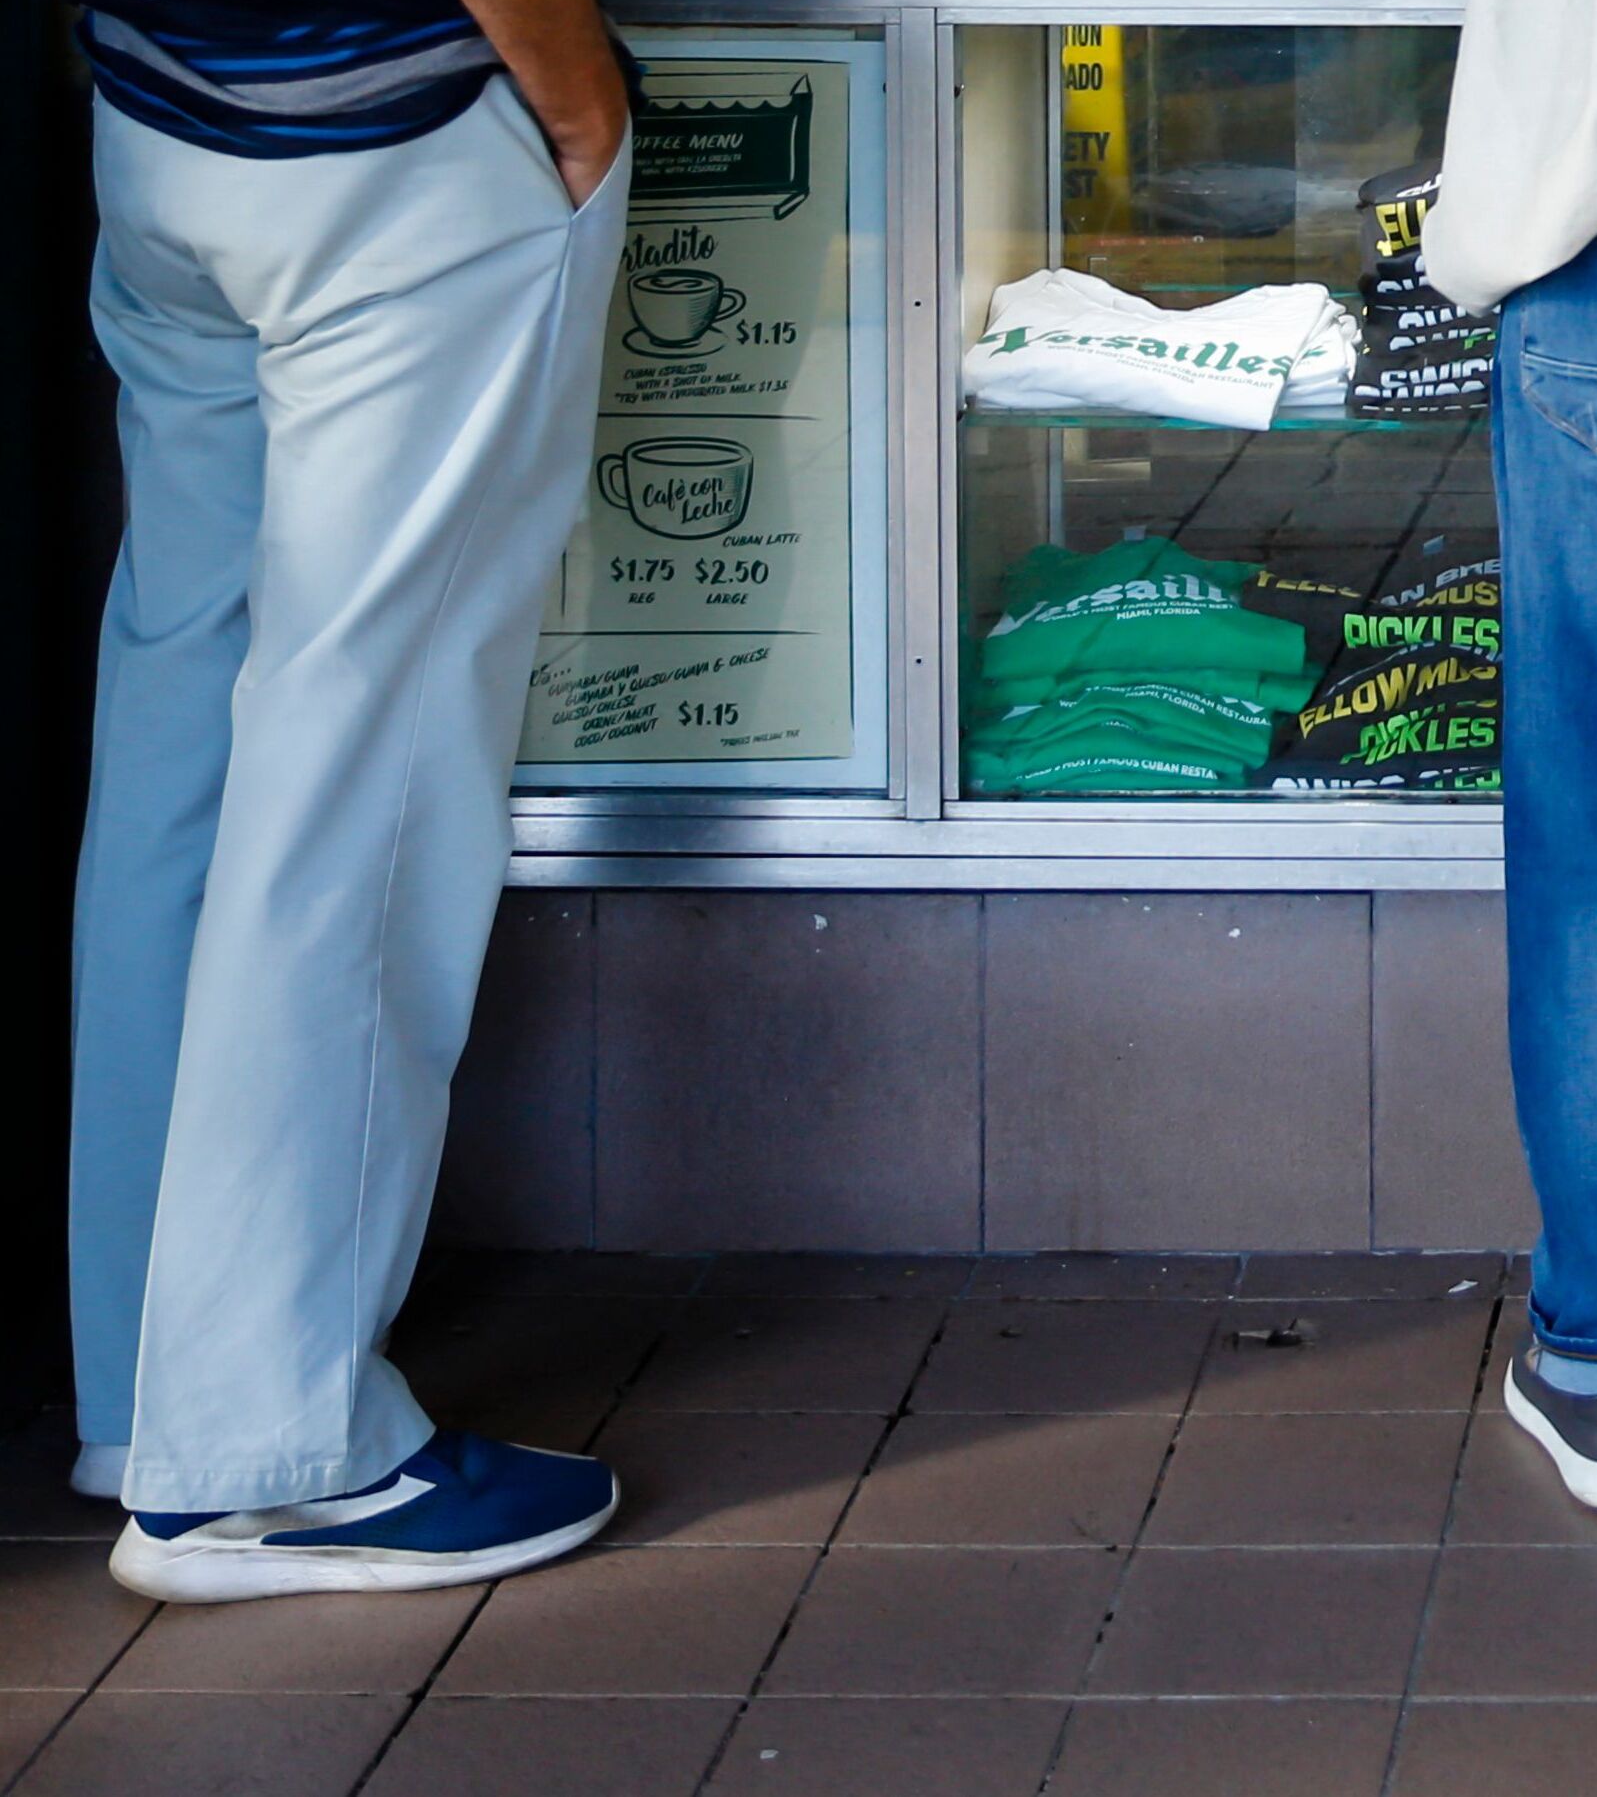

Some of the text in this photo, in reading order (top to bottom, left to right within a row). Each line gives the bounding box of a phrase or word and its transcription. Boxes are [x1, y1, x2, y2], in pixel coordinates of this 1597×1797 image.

[1062, 62, 1104, 91] ADO
[689, 133, 744, 150] MENU
[736, 318, 797, 346] $1.15
[636, 379, 662, 391] WITH
[716, 373, 743, 384] MILK
[641, 390, 667, 402] WITH
[729, 384, 755, 395] MILK
[681, 490, 736, 525] Leche
[722, 533, 762, 548] CUBAN
[610, 556, 770, 586] $1.75 $2.50
[628, 591, 749, 605] REG LARGE
[1154, 607, 1202, 617] FLORIDA
[729, 647, 771, 667] CHEESE
[1162, 691, 1206, 715] FLORIDA
[678, 700, 739, 727] $1.15
[1215, 703, 1273, 726] RESTAURA
[1140, 758, 1180, 773] CUBAN
